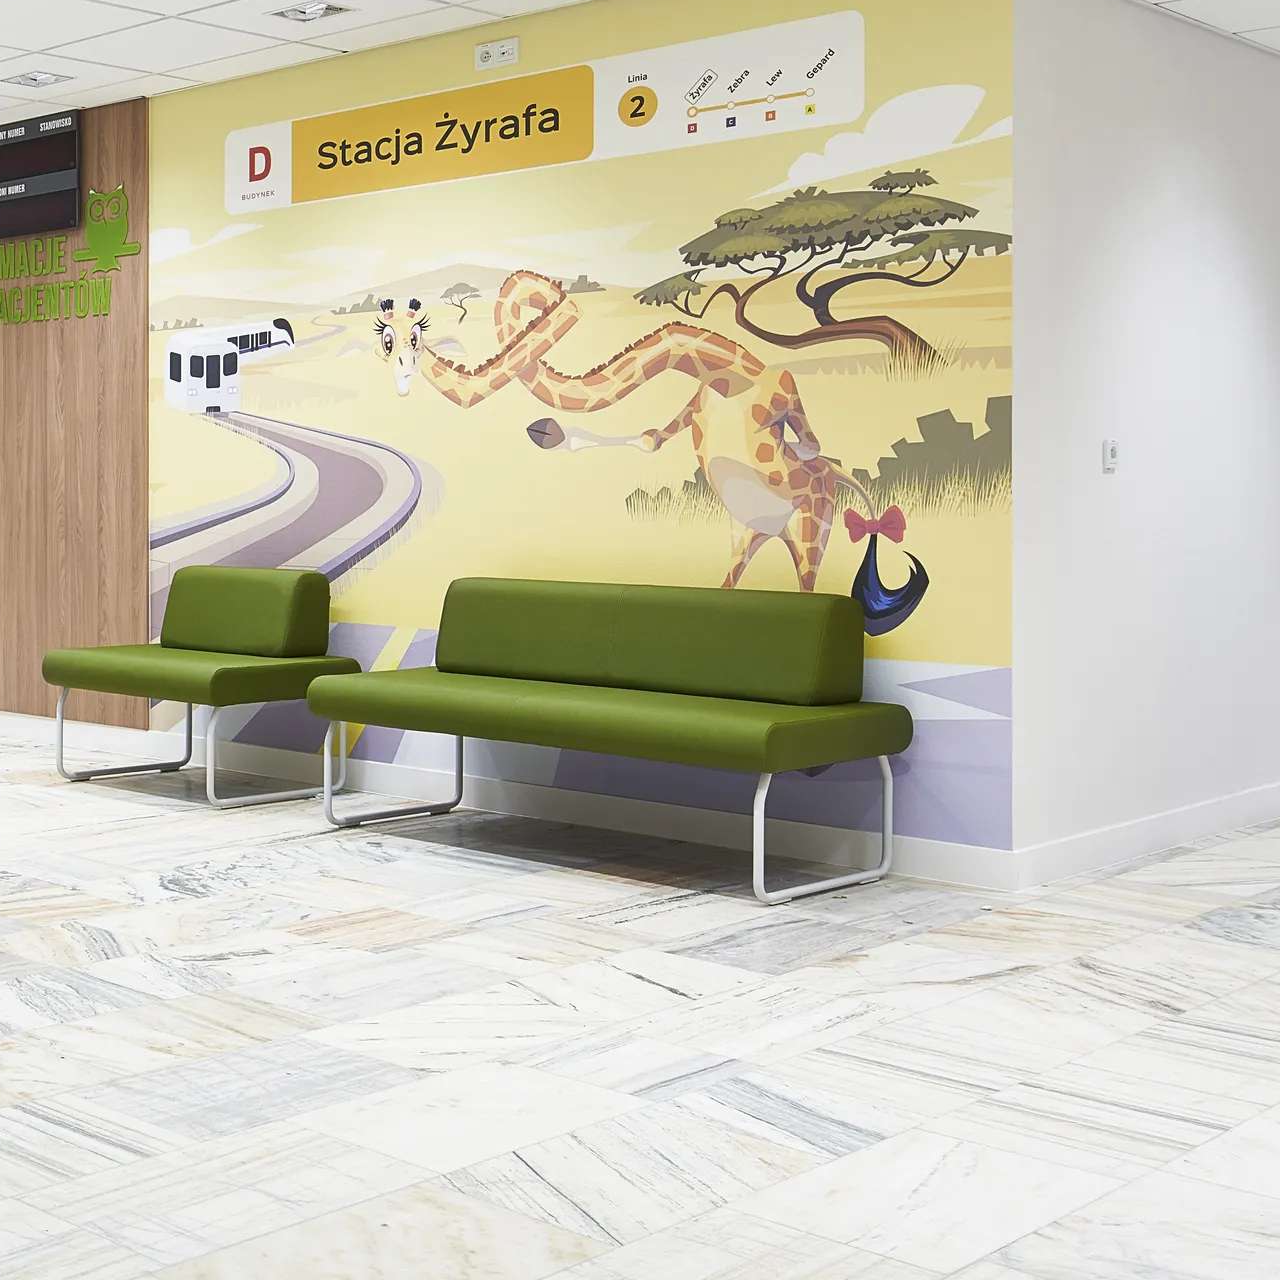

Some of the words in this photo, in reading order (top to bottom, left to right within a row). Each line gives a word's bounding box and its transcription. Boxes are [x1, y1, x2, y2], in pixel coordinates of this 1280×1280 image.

[806, 48, 835, 80] Gepard
[628, 73, 648, 83] Linia
[689, 74, 713, 100] Żyrafa
[727, 69, 750, 93] Zebra
[766, 69, 783, 87] Lew
[630, 95, 646, 118] 2
[807, 105, 813, 113] A
[7, 126, 25, 139] NUMER
[39, 116, 72, 132] STANOWISKO
[317, 128, 423, 170] Stacja
[435, 103, 560, 154] Żyrafa
[248, 146, 272, 183] D
[7, 183, 25, 196] NUMER
[241, 189, 275, 201] BUDYNEK
